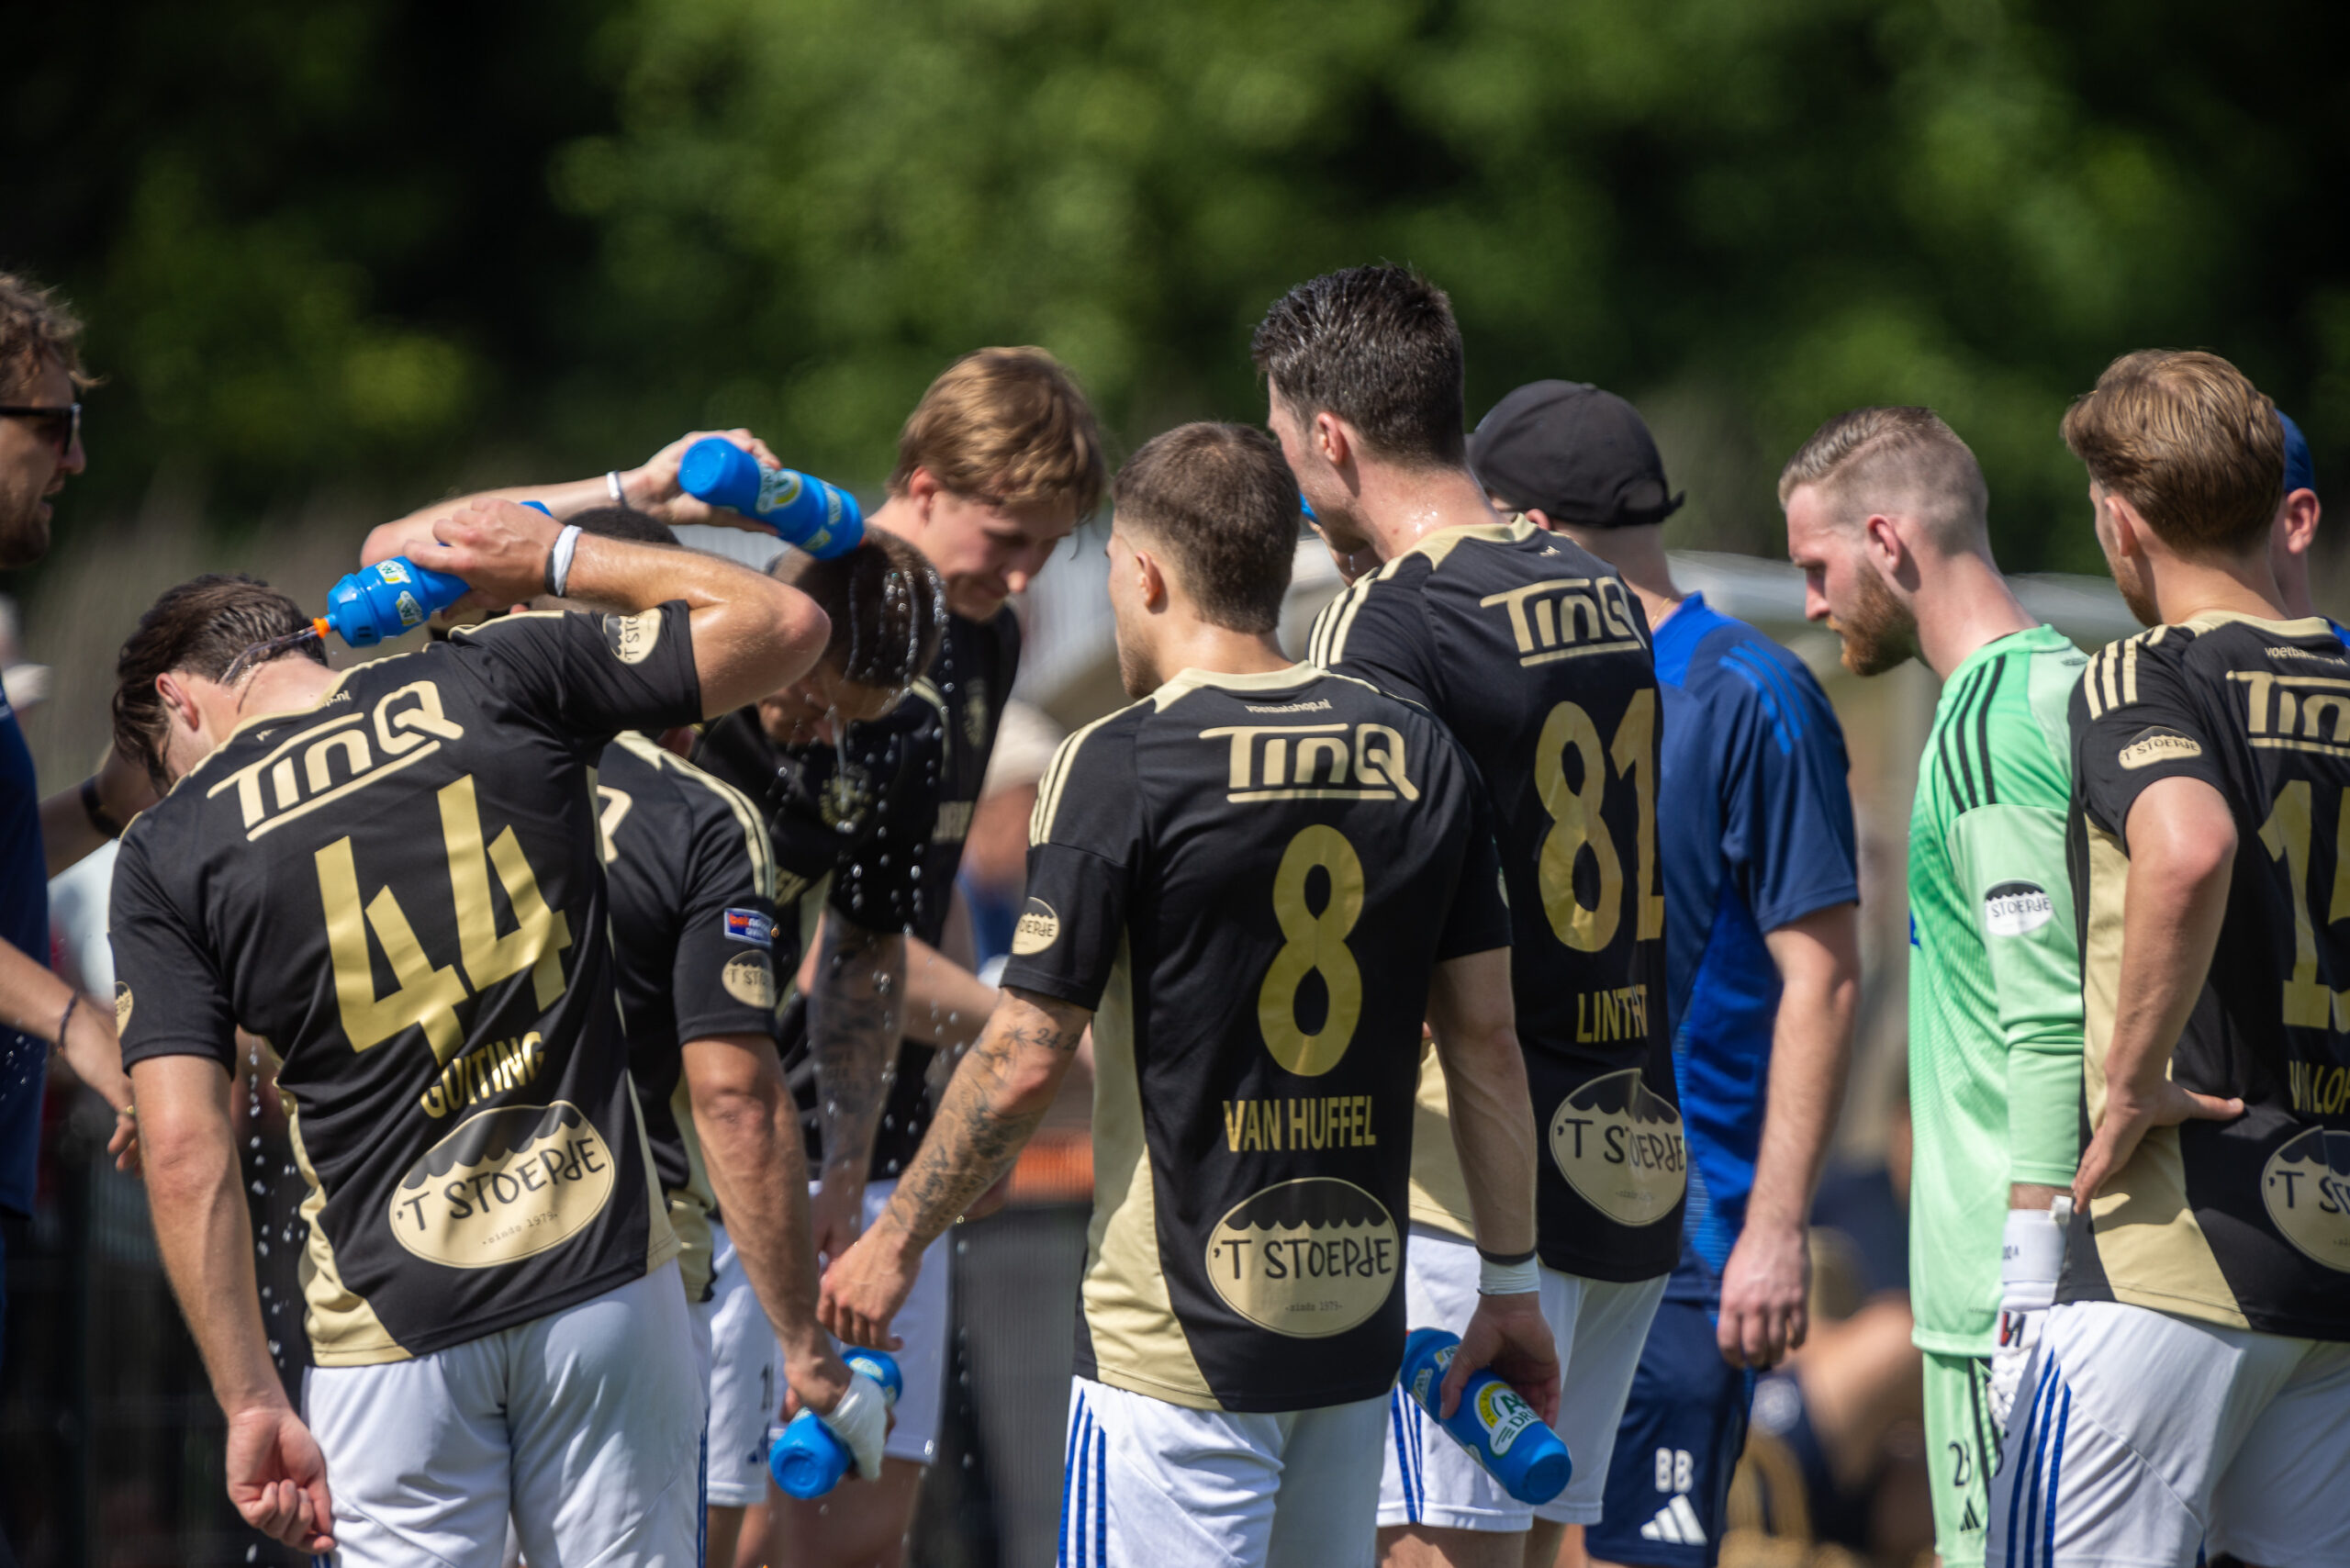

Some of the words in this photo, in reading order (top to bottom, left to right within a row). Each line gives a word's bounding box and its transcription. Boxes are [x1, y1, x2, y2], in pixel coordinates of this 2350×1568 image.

[1534, 688, 1665, 954] 81
[314, 774, 573, 1069] 44
[1258, 823, 1365, 1077] 8
[419, 1030, 545, 1120] GUITING
[1224, 1097, 1281, 1152] VAN
[1288, 1095, 1377, 1151] HUFFEL
[1604, 1125, 1685, 1173] SOEPJE
[396, 1192, 431, 1232] 'T
[442, 1137, 607, 1220] STOEPJE
[1214, 1238, 1252, 1281] 'T
[1263, 1236, 1393, 1281] STOEPJE
[1654, 1447, 1695, 1495] BB
